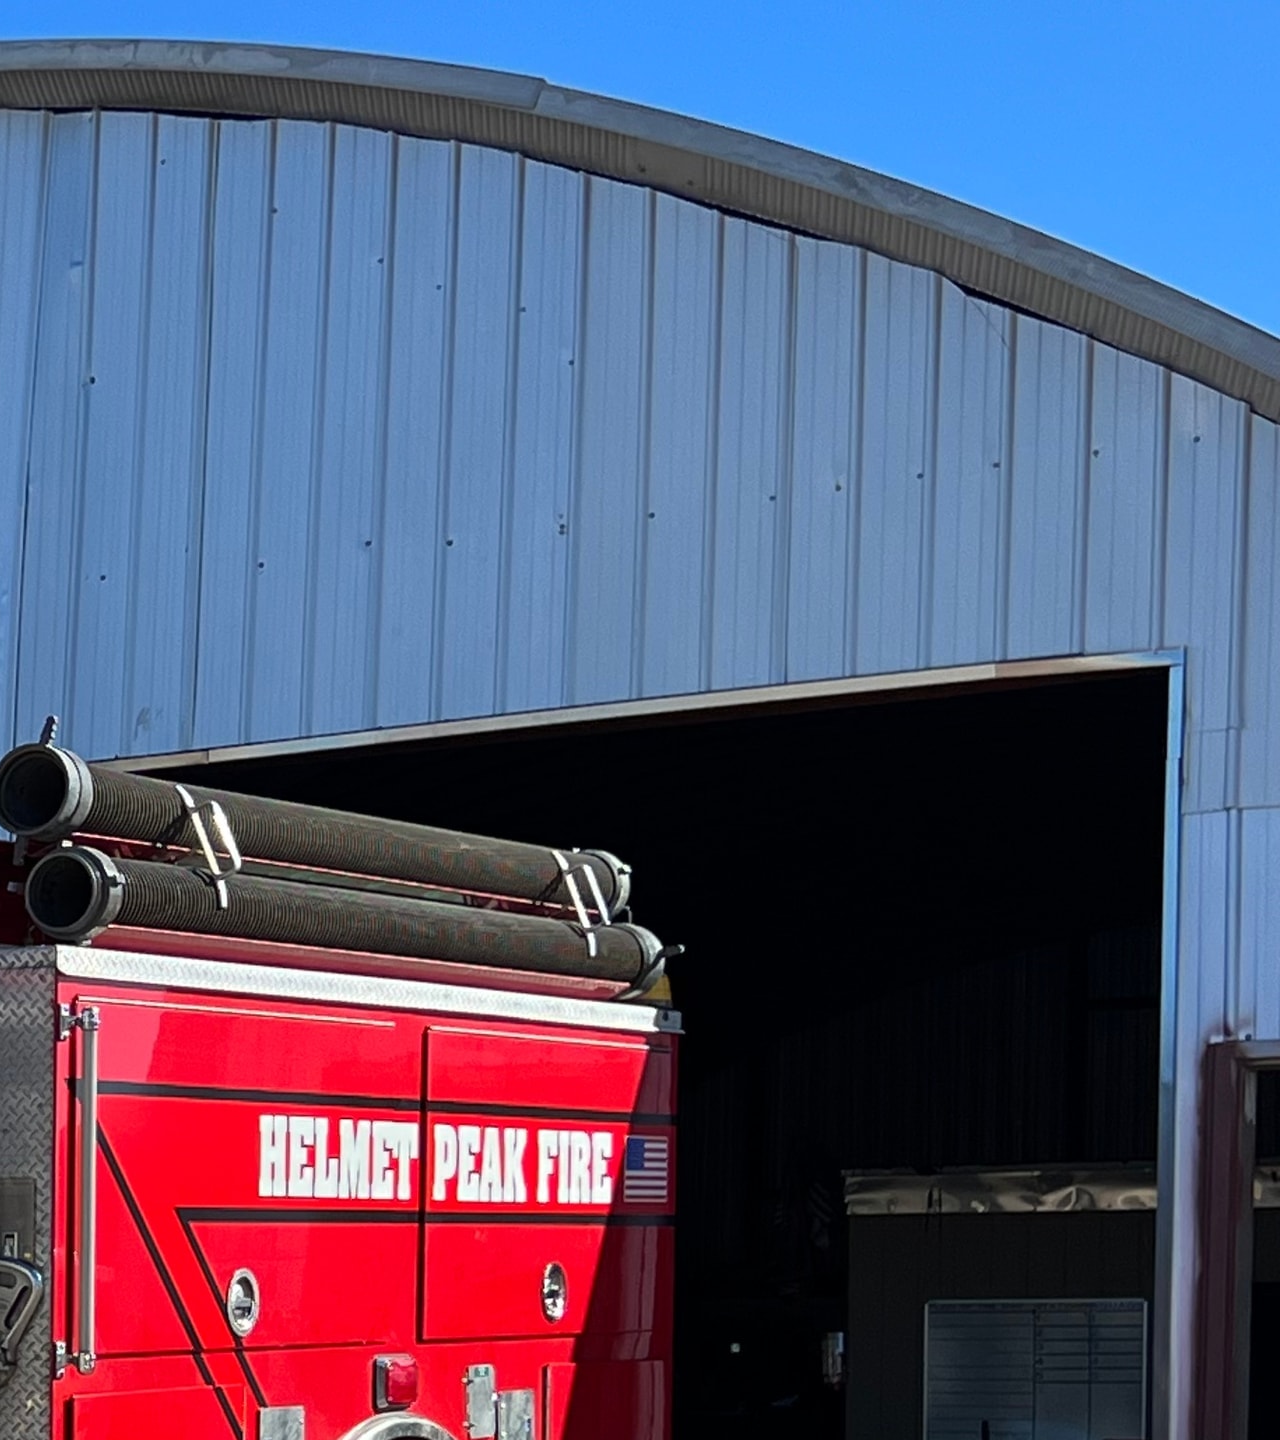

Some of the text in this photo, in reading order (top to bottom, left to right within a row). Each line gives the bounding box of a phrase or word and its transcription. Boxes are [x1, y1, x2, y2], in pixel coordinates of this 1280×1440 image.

[258, 1114, 614, 1205] HELMET PEAK FIRE
